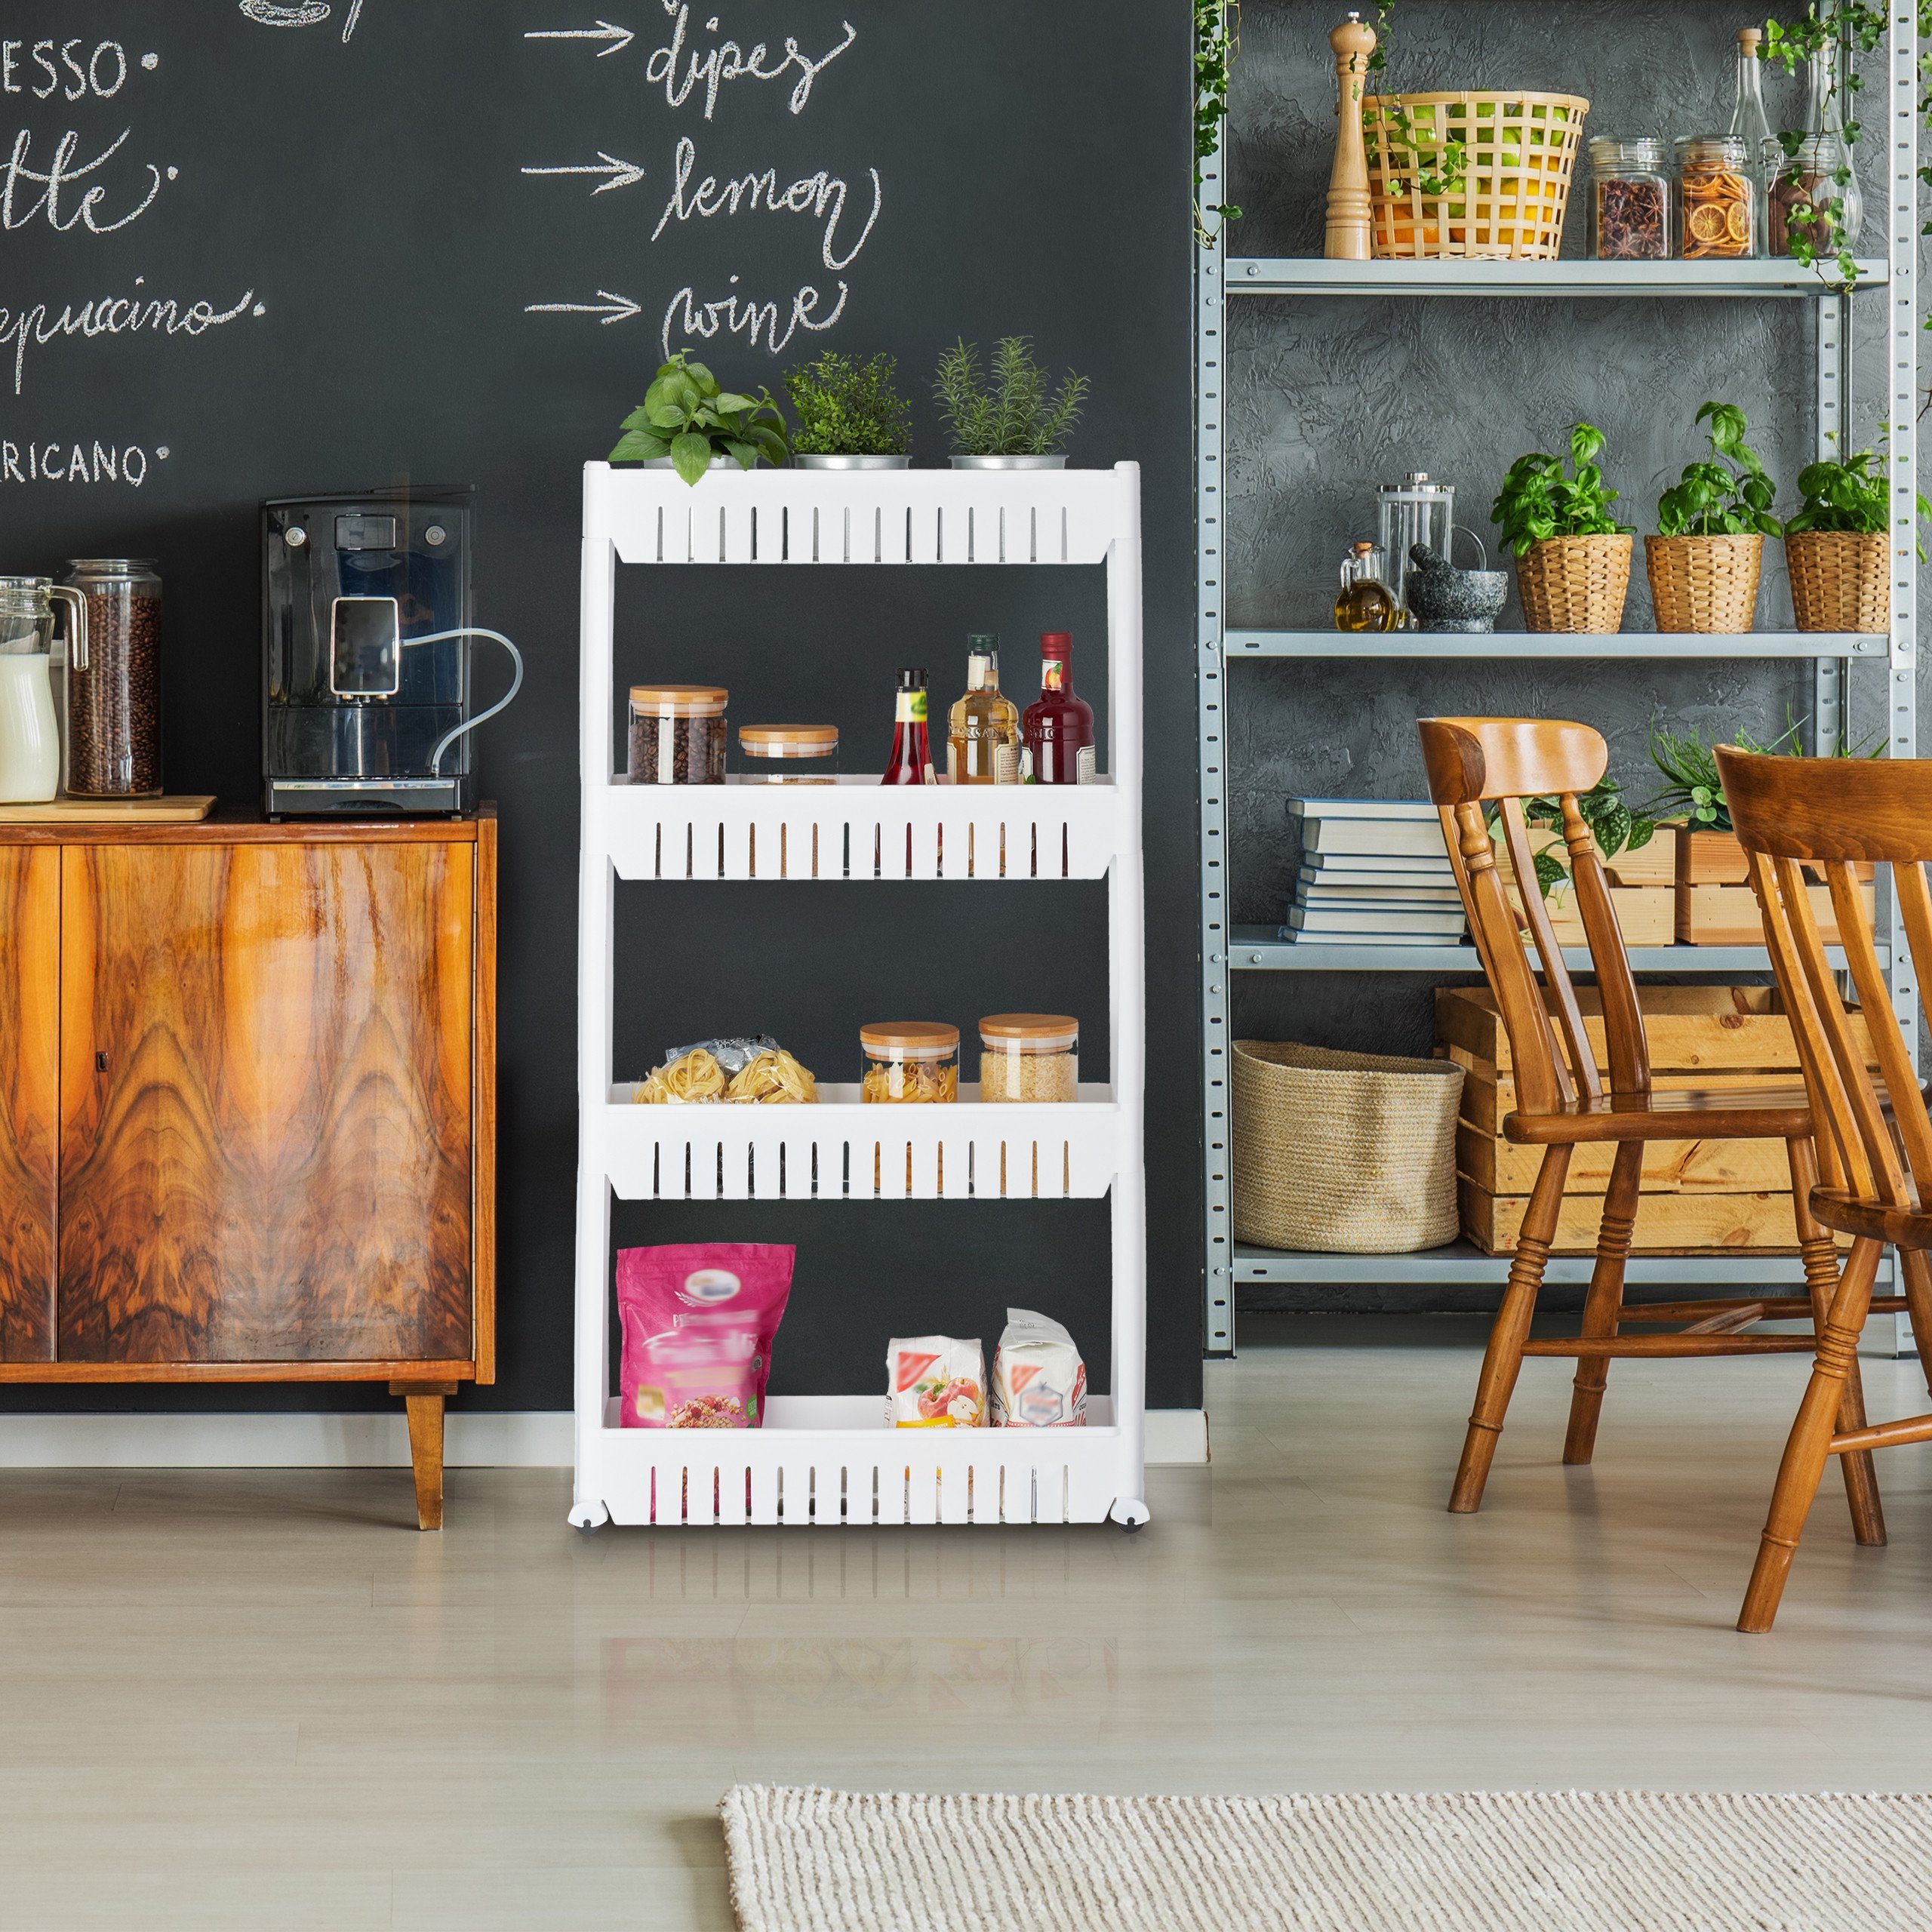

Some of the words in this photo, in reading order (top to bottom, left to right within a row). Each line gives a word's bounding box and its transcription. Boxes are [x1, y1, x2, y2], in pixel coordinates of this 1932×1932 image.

[0, 128, 161, 234] tte
[652, 137, 882, 271] lemon
[663, 275, 849, 361] wine
[0, 441, 147, 488] RICANO
